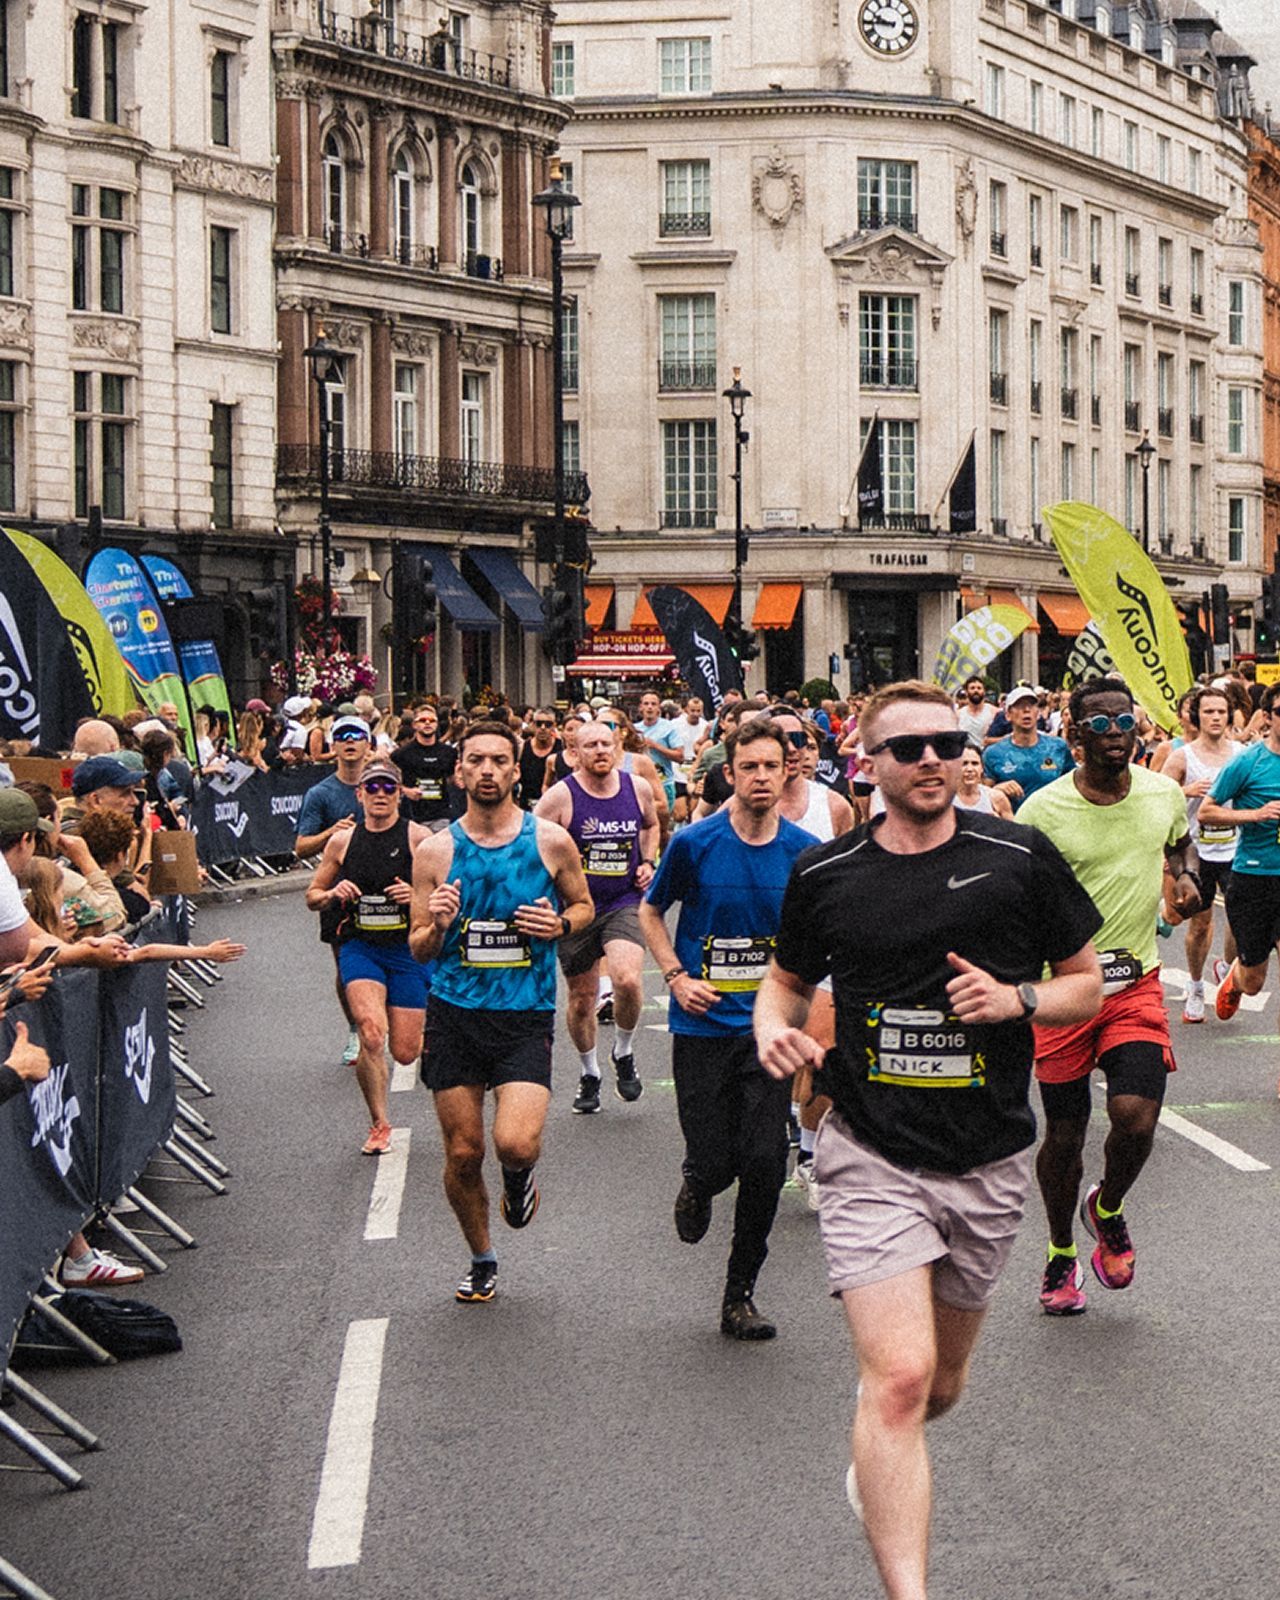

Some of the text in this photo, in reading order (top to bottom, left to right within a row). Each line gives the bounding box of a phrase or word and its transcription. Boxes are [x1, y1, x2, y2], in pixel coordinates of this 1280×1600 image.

[869, 554, 928, 566] TRAFALGAR
[599, 820, 638, 833] MS-UK
[485, 935, 518, 944] B 11111
[728, 952, 766, 962] B 7102
[904, 1033, 966, 1048] B 6016
[890, 1059, 943, 1074] NICK
